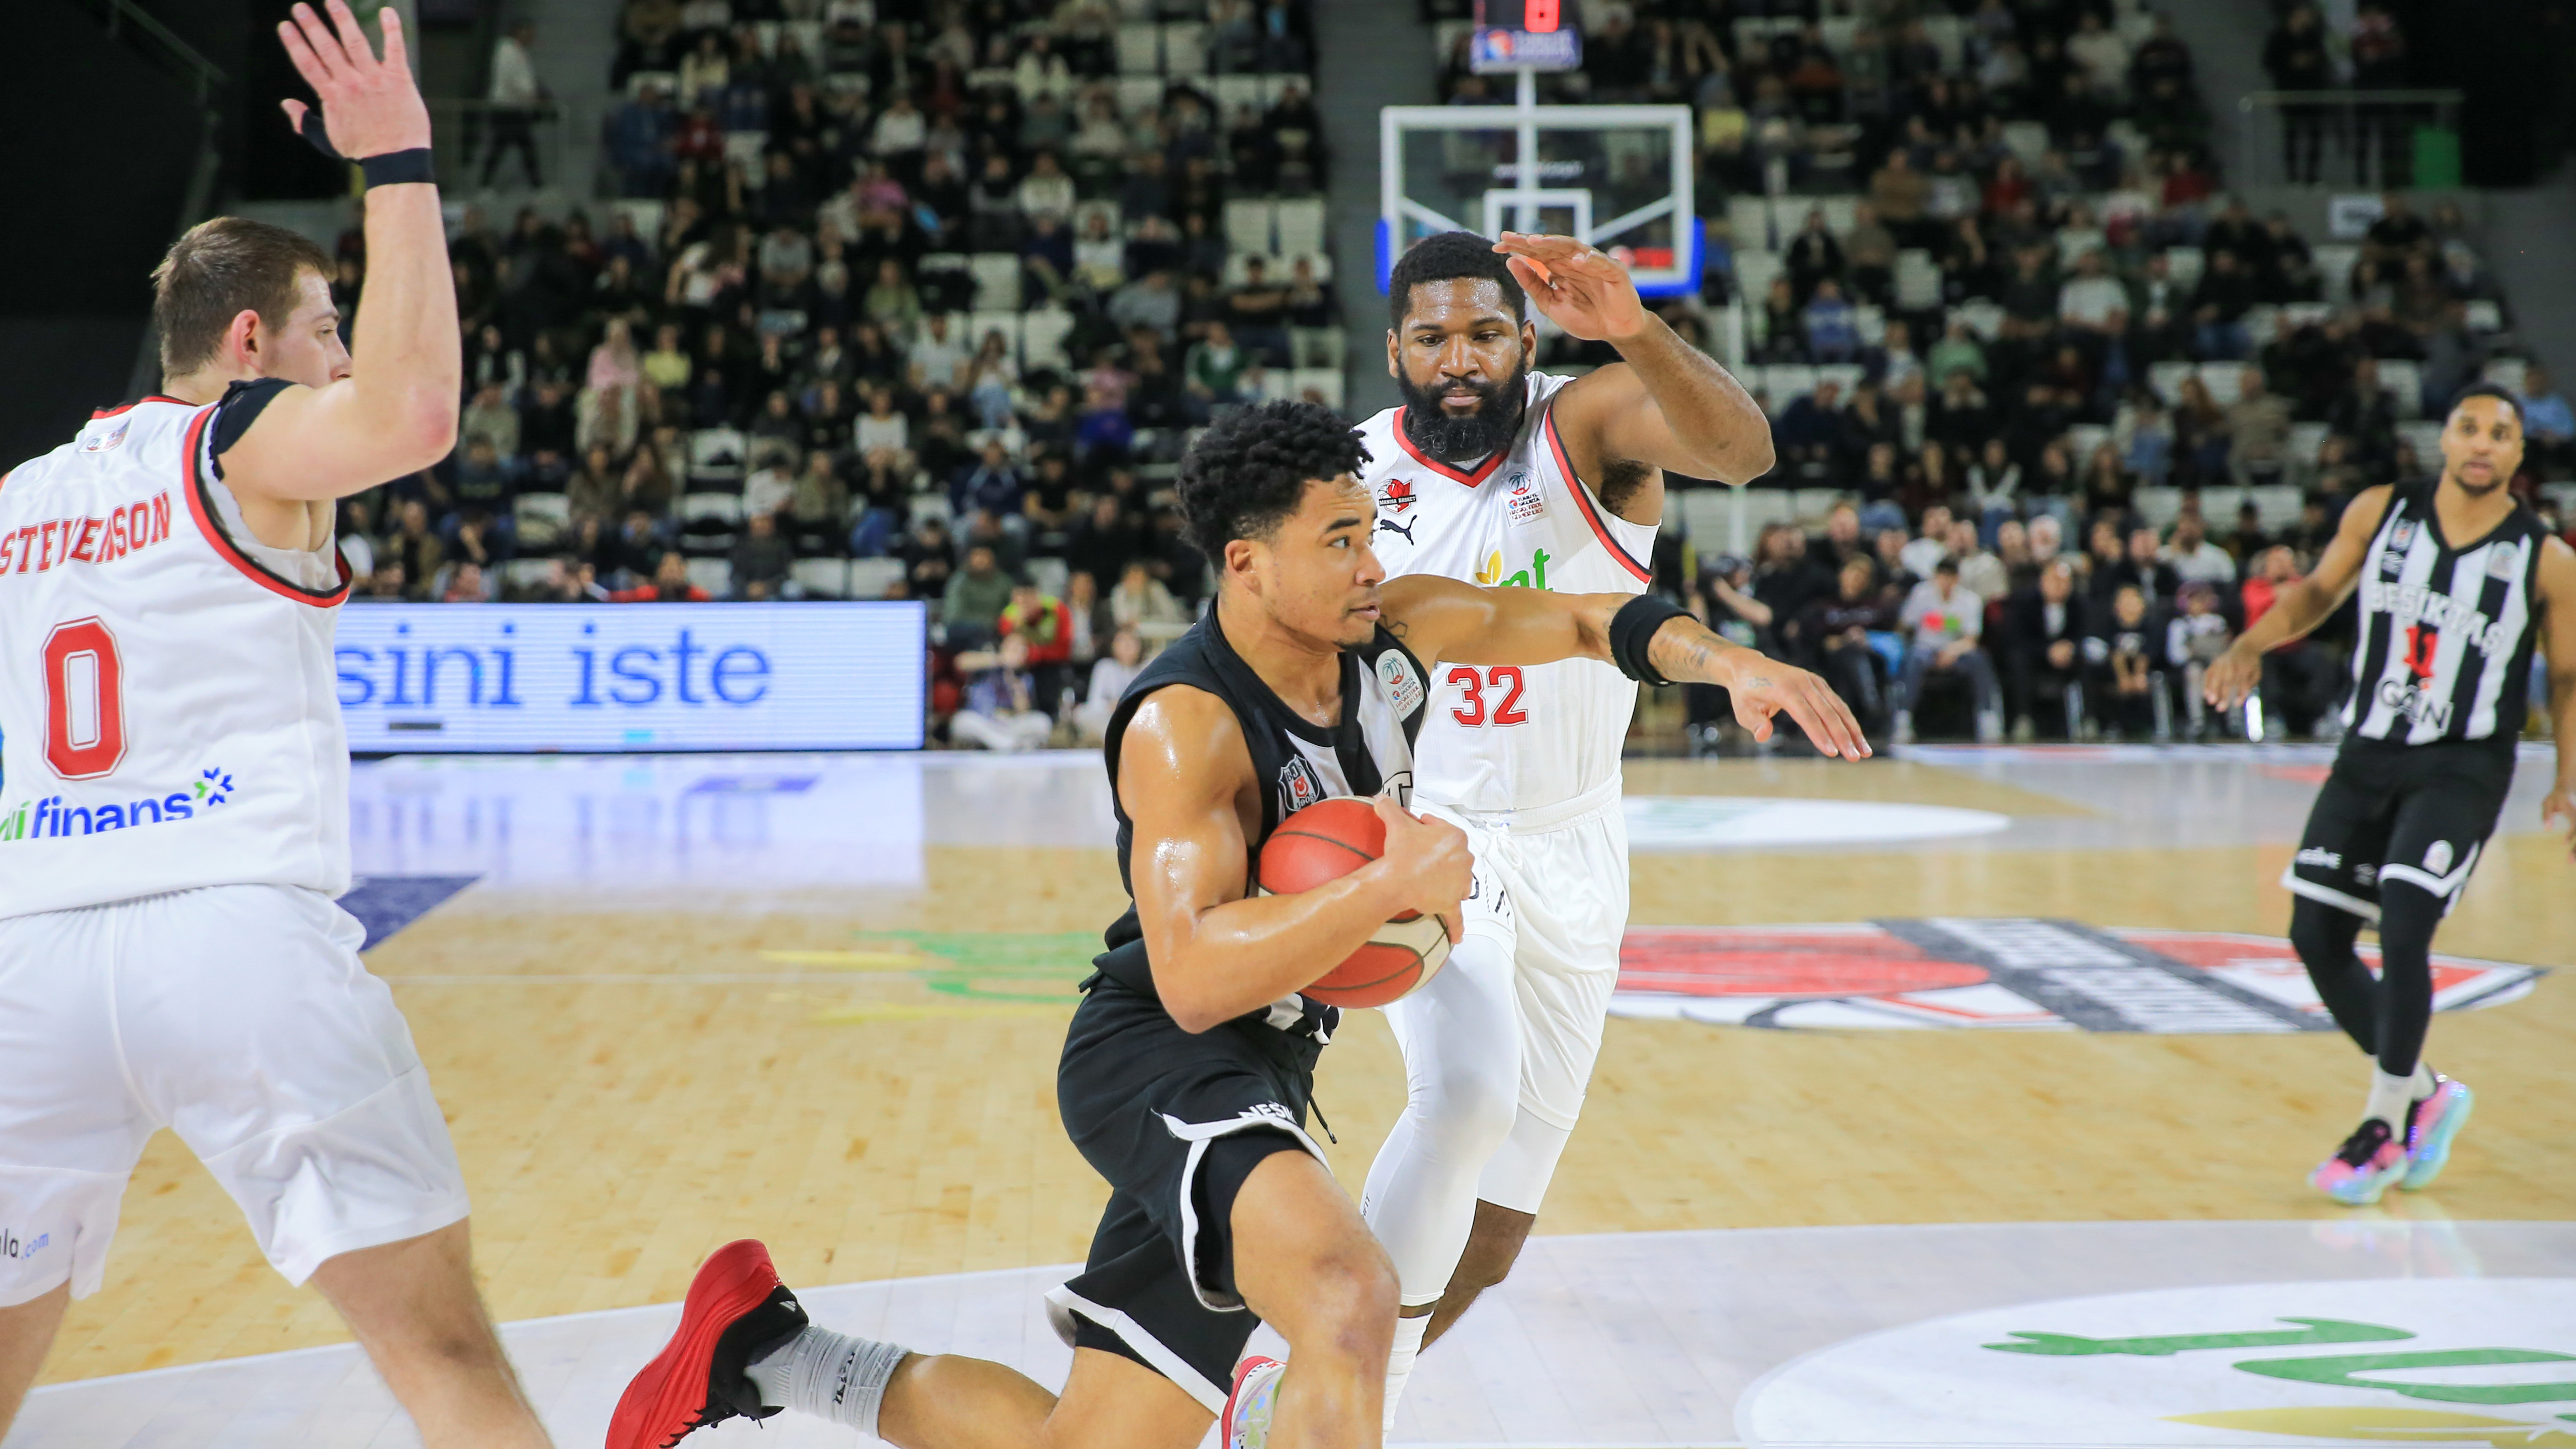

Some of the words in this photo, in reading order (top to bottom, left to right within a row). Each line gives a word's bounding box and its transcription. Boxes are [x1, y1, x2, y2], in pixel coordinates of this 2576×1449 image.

[569, 623, 771, 706] iste
[41, 615, 128, 781] 0
[1446, 665, 1529, 728] 32
[1296, 793, 1315, 809] 1903
[0, 1228, 49, 1260] la.com
